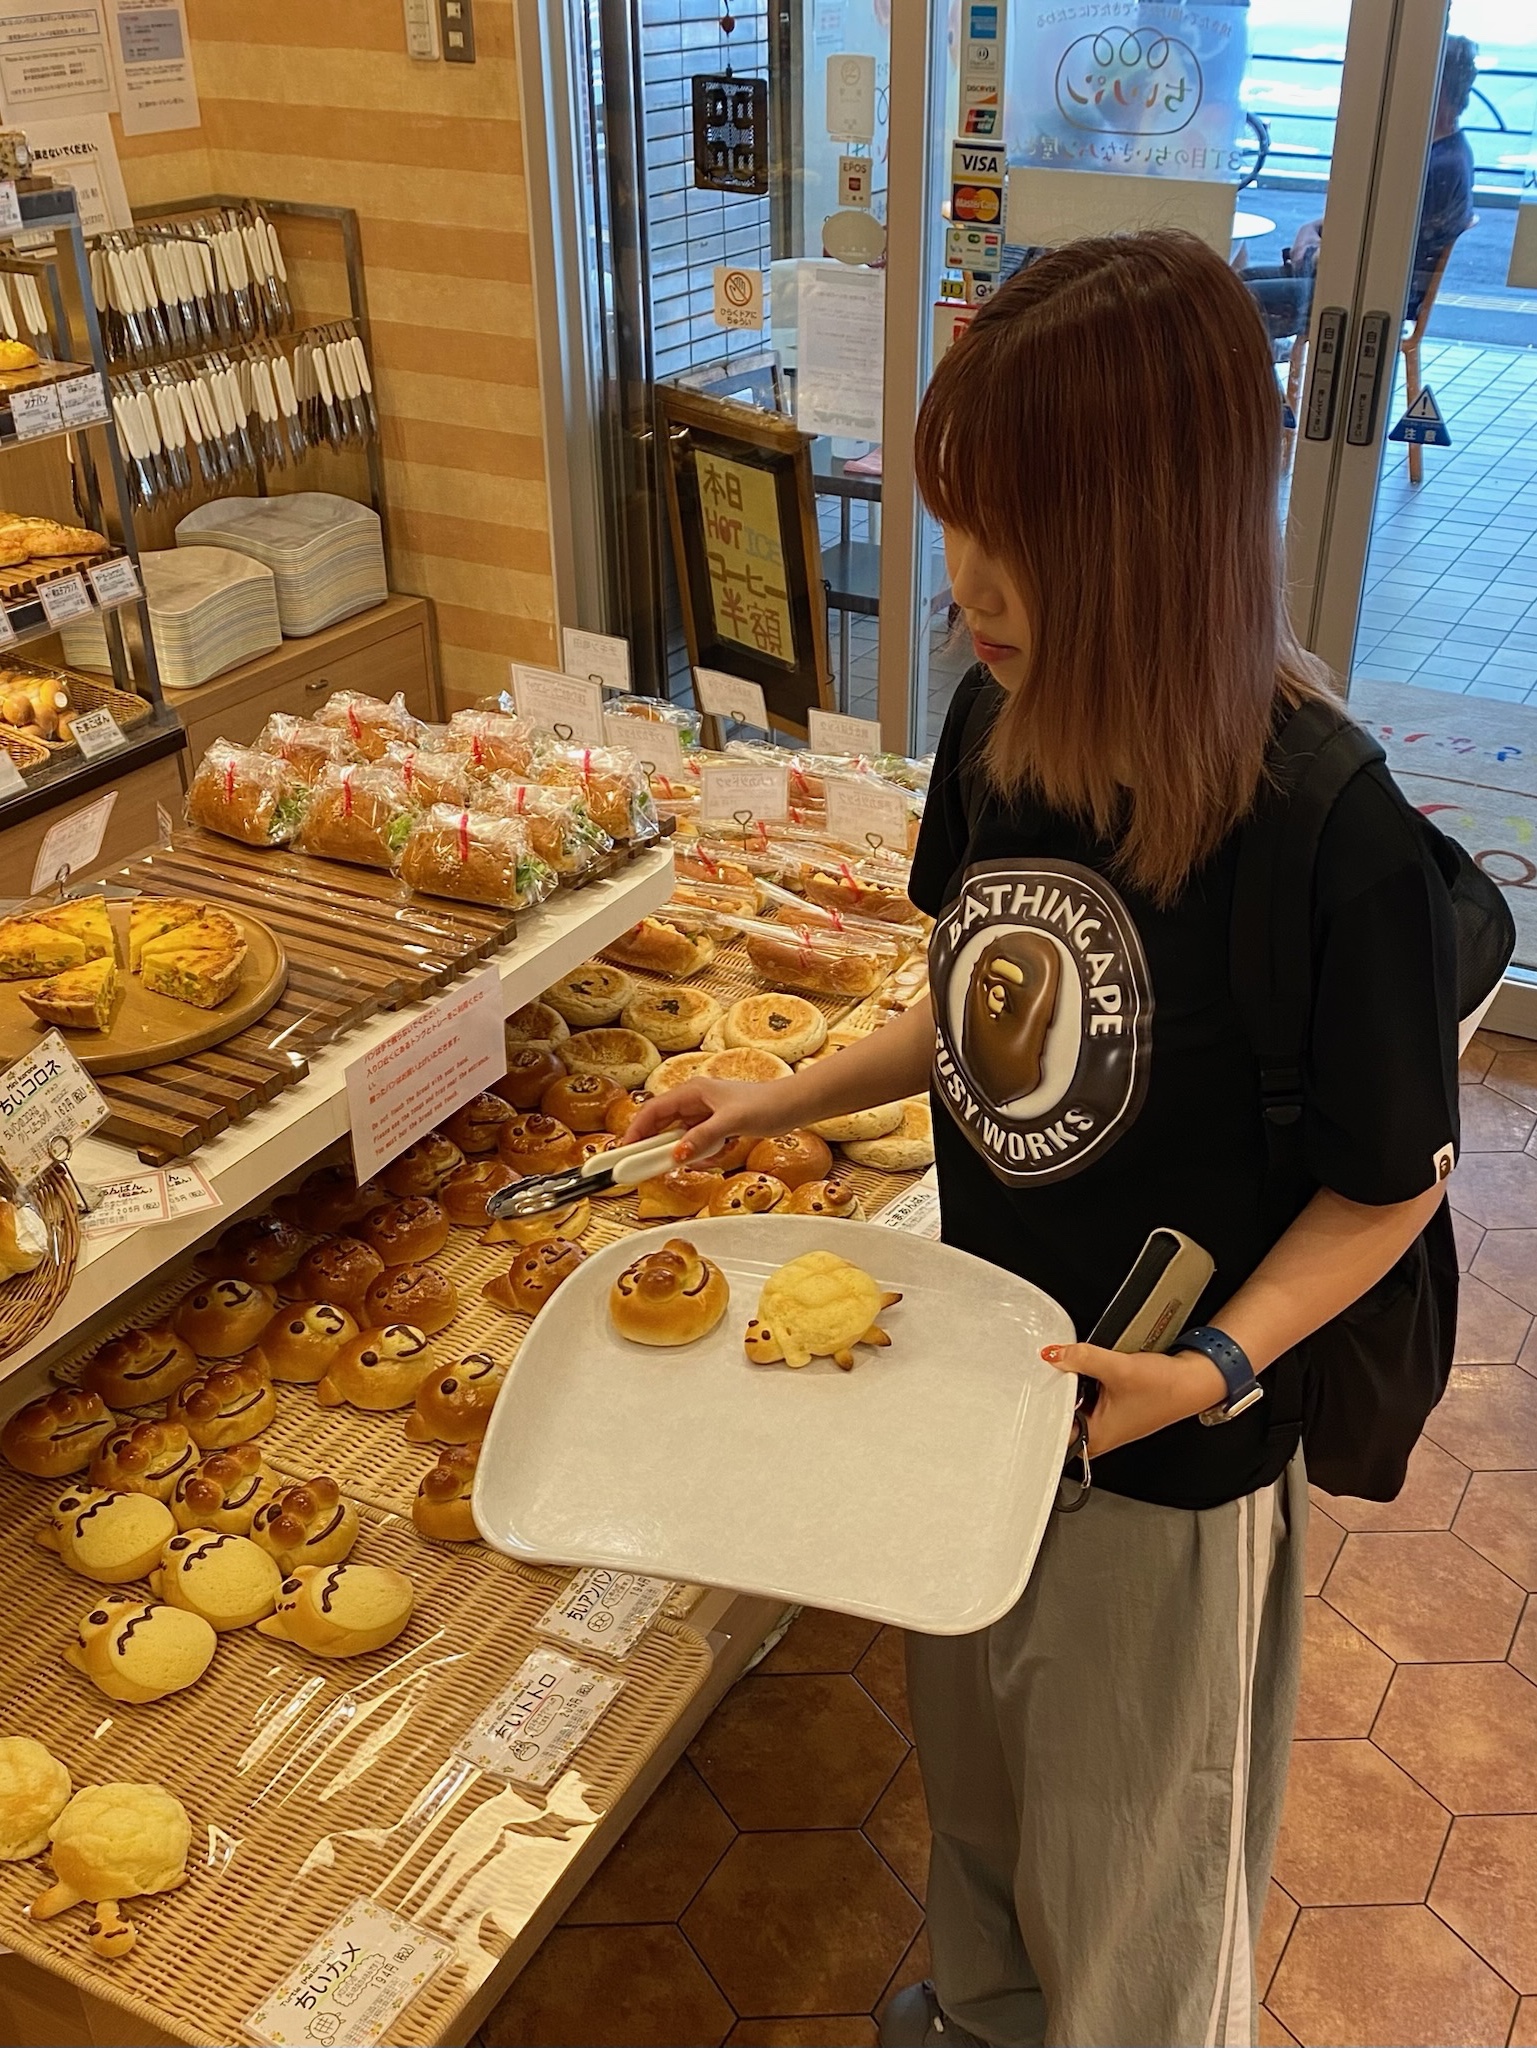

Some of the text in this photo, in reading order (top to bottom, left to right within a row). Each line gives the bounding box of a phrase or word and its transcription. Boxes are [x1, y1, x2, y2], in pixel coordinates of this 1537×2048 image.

[966, 84, 996, 92] DISCOVER
[843, 161, 867, 174] EPOS
[962, 154, 998, 173] VISA
[943, 281, 963, 295] iD
[1322, 327, 1335, 354] 自動
[1363, 331, 1377, 358] 自動
[1403, 427, 1437, 442] 注意
[703, 463, 743, 511] 本日
[705, 506, 742, 550] HOT
[708, 551, 787, 600] コーヒー
[720, 587, 782, 655] 半額
[1085, 952, 1124, 1037] APE
[0, 1059, 60, 1115] ちいコロネ
[6, 1063, 37, 1091] Mini korone
[53, 1097, 75, 1118] 162円
[981, 1106, 1095, 1162] WORKS
[566, 1570, 611, 1620] ちいアンパン
[629, 1576, 651, 1596] 194円
[494, 1673, 556, 1740] ちいトトロ
[294, 1941, 360, 2009] ちいカメ
[370, 1943, 415, 1988] 194円 (税込)
[279, 1986, 301, 2006] Turtle
